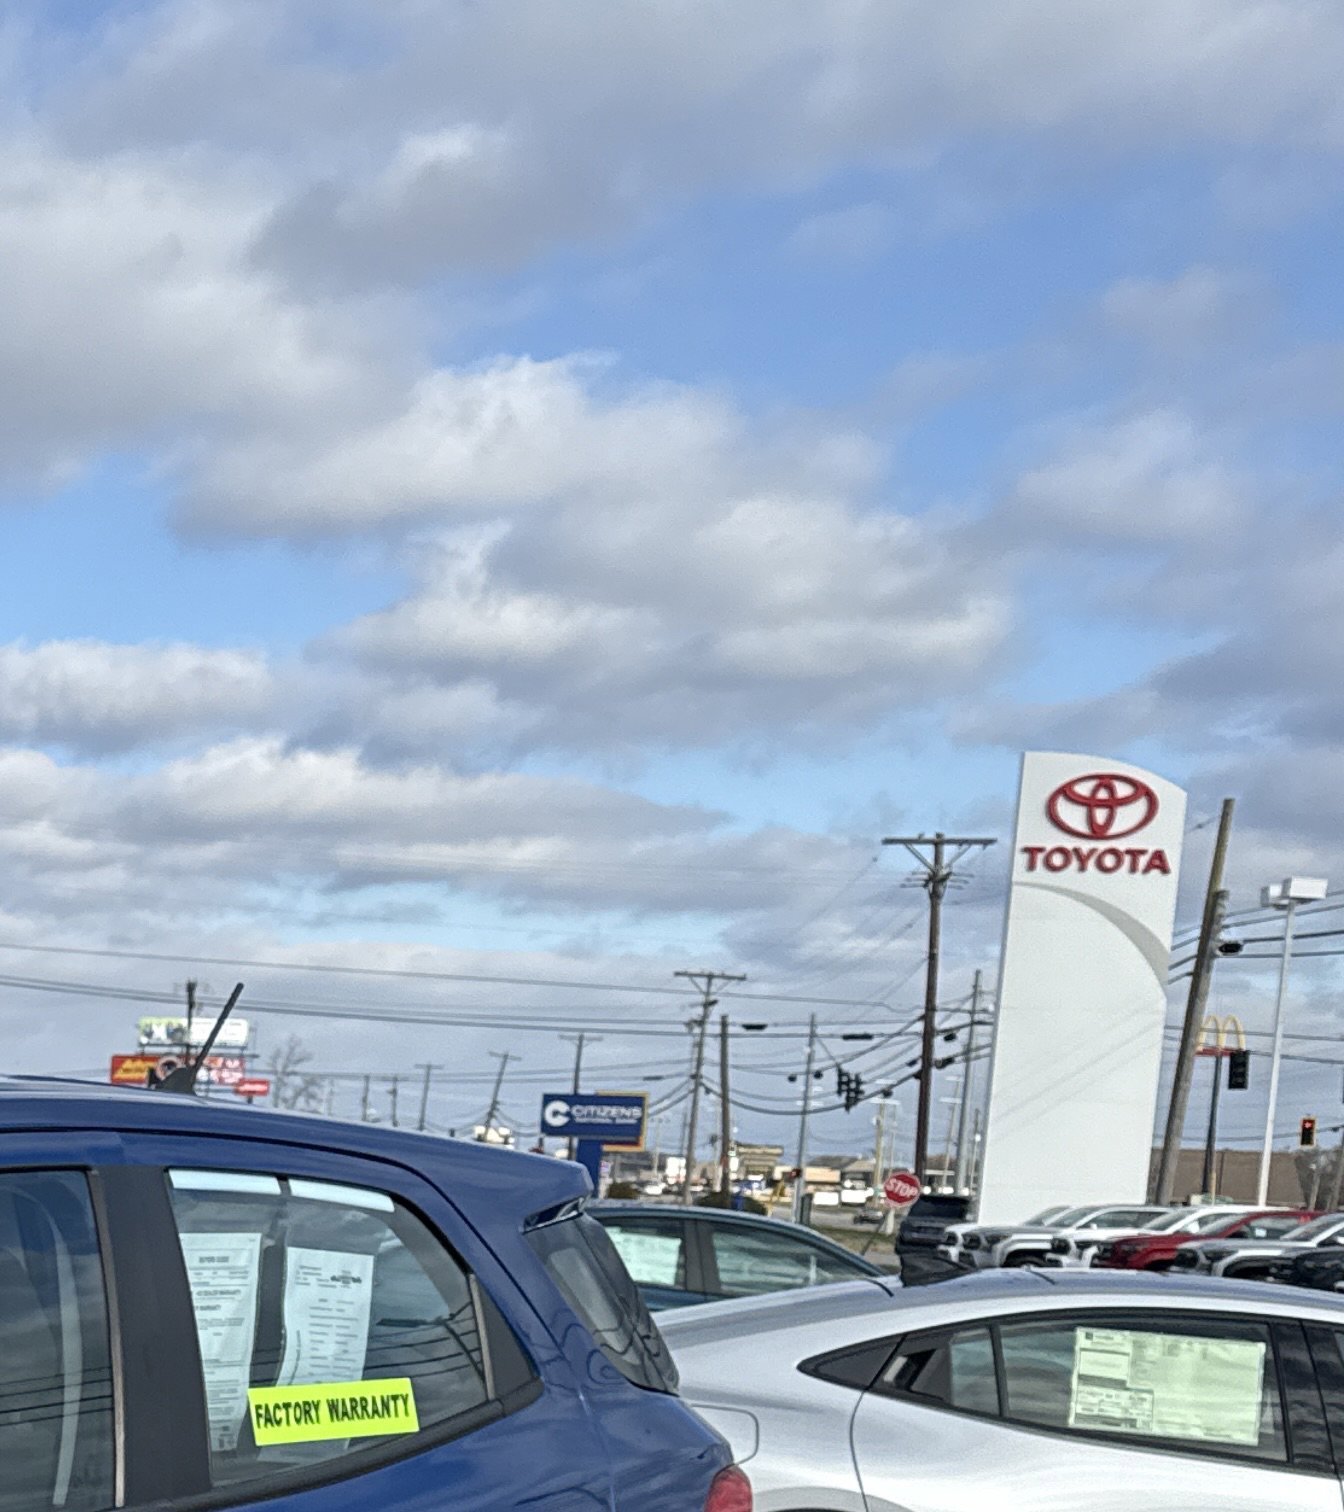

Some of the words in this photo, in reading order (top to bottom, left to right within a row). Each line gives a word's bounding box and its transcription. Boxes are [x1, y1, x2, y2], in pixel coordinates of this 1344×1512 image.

[1021, 845, 1172, 876] TOYOTA
[885, 1178, 919, 1197] STOP
[254, 1399, 322, 1429] FACTORY
[326, 1394, 411, 1424] WARRANTY
